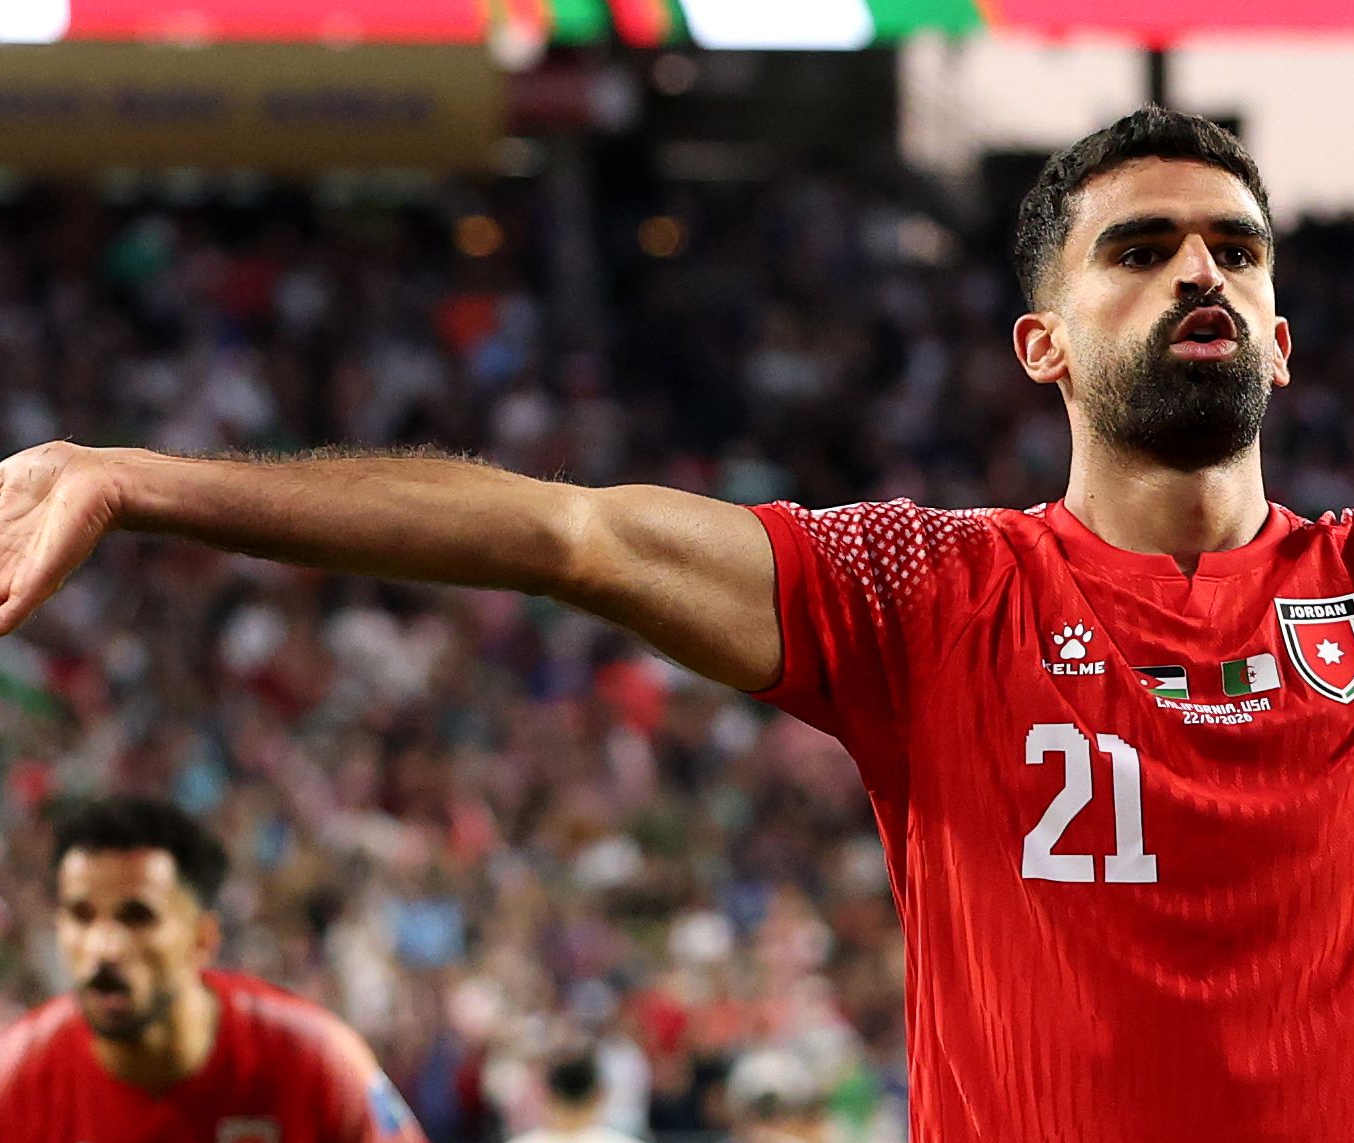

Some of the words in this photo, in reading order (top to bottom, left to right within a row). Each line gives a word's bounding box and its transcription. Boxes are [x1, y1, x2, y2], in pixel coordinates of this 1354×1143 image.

[1289, 603, 1347, 618] JORDAN
[1042, 659, 1106, 675] KELME
[1240, 698, 1271, 712] USA
[1022, 723, 1158, 883] 21
